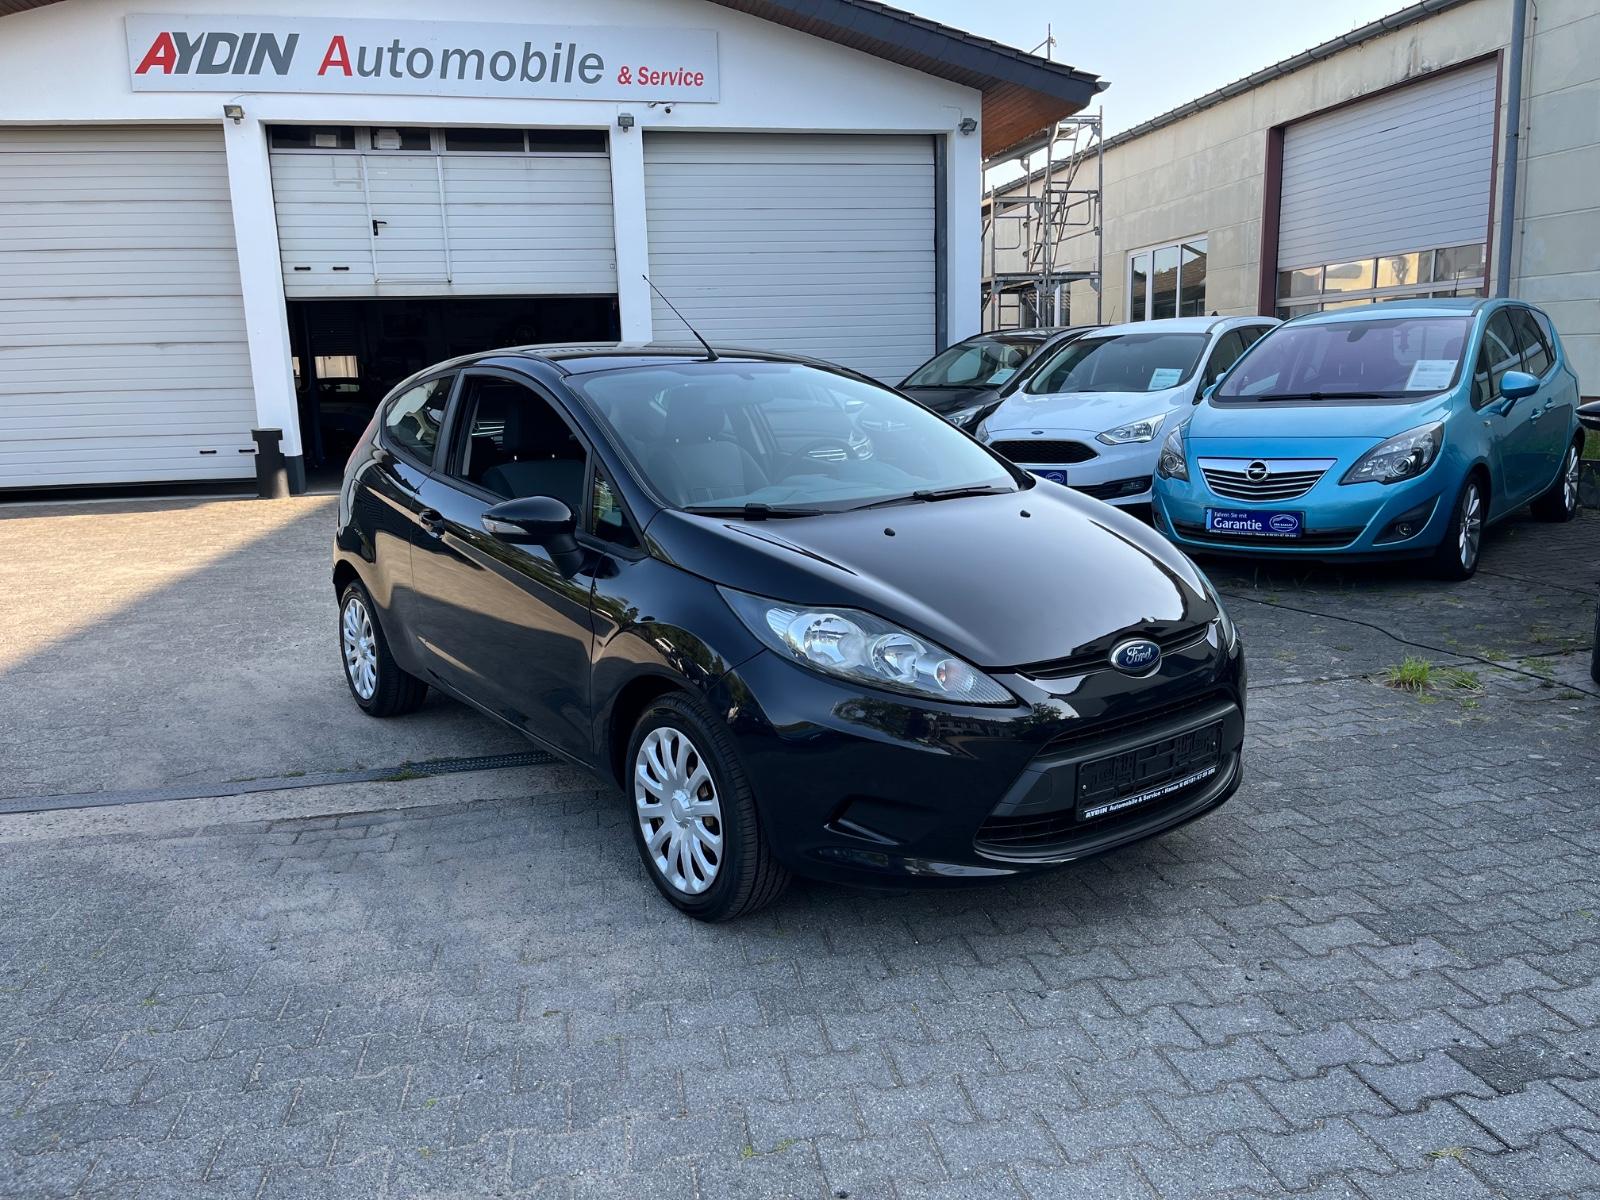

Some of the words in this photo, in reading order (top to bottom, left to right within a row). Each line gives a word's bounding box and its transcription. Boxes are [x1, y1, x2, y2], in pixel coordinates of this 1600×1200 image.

[135, 32, 300, 75] AYDIN
[317, 35, 605, 84] Automobile
[617, 65, 632, 85] &
[637, 66, 704, 86] Service
[1213, 517, 1262, 531] Garantie
[1125, 645, 1153, 664] Ford
[1085, 807, 1108, 818] AYDIN
[1109, 799, 1138, 811] Automobile
[1143, 791, 1161, 801] Service
